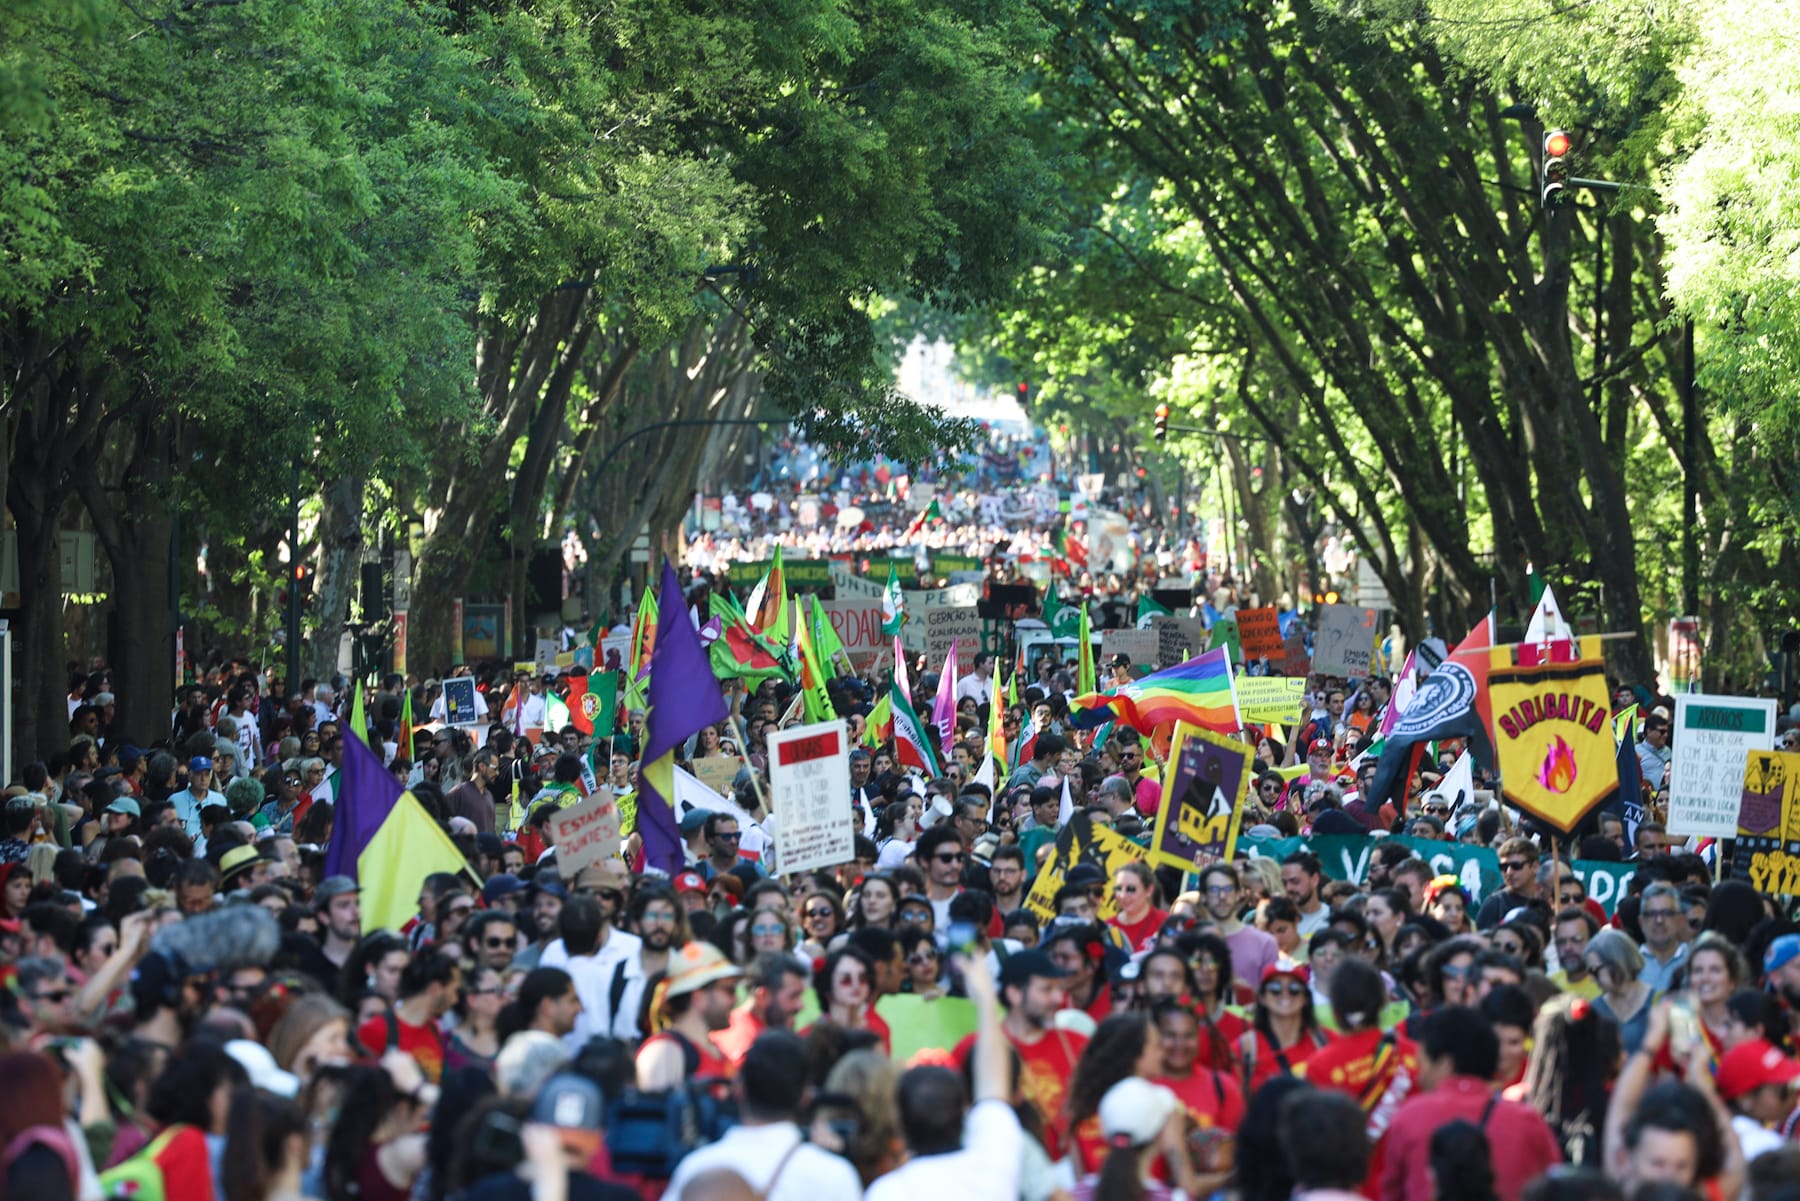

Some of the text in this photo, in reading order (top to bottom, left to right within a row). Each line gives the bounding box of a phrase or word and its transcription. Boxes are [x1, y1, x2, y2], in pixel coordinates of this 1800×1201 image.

[835, 574, 977, 605] UNIDS PELA
[928, 626, 978, 637] QUALIFICADA
[1498, 692, 1607, 740] SIRIGAITA
[1681, 745, 1700, 760] COM
[1681, 762, 1698, 779] COM
